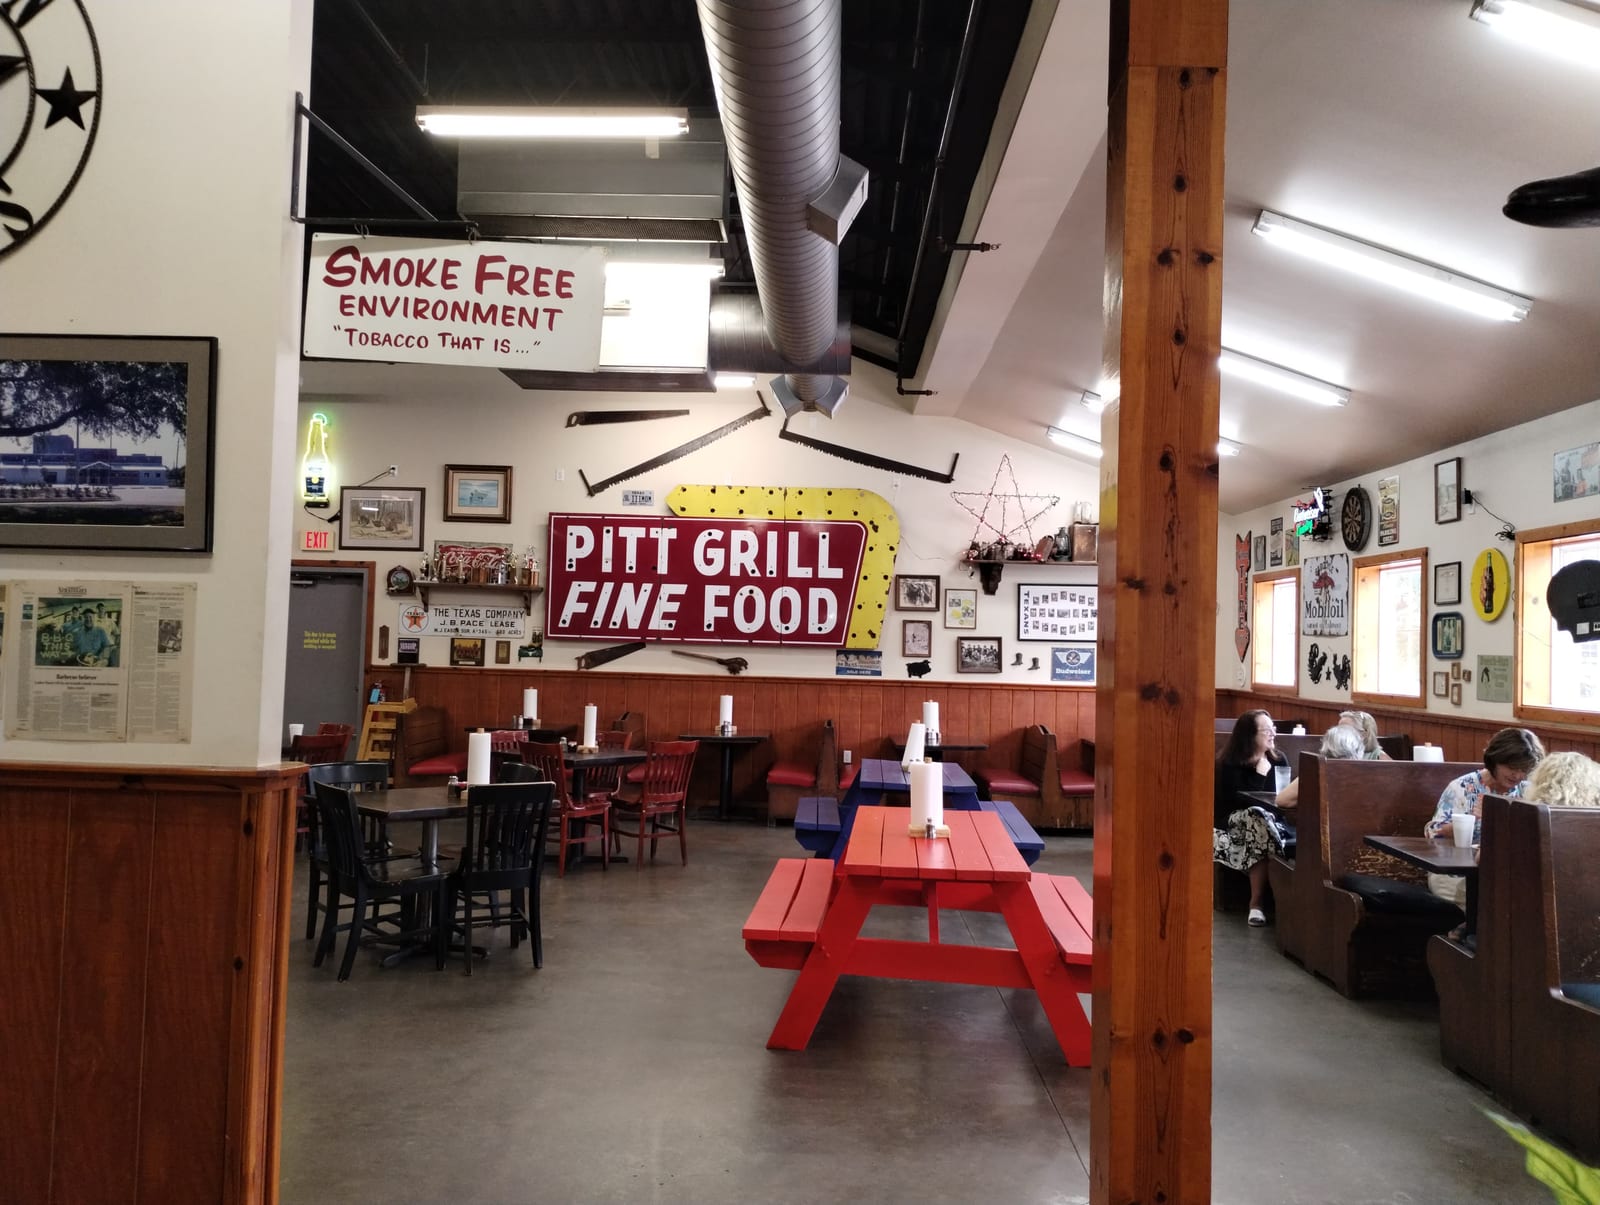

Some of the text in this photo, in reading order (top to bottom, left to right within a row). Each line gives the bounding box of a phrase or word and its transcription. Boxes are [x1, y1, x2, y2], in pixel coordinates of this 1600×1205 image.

[322, 245, 576, 299] SMOKE FREE
[339, 294, 564, 332] ENVIRONMENT
[437, 332, 484, 351] THAT
[306, 531, 328, 549] EXIT
[565, 525, 844, 579] PITT GRILL
[434, 608, 525, 619] THE TEXAS COMPANY
[558, 581, 838, 635] FINE FOOD
[1304, 598, 1345, 618] Mobiloil
